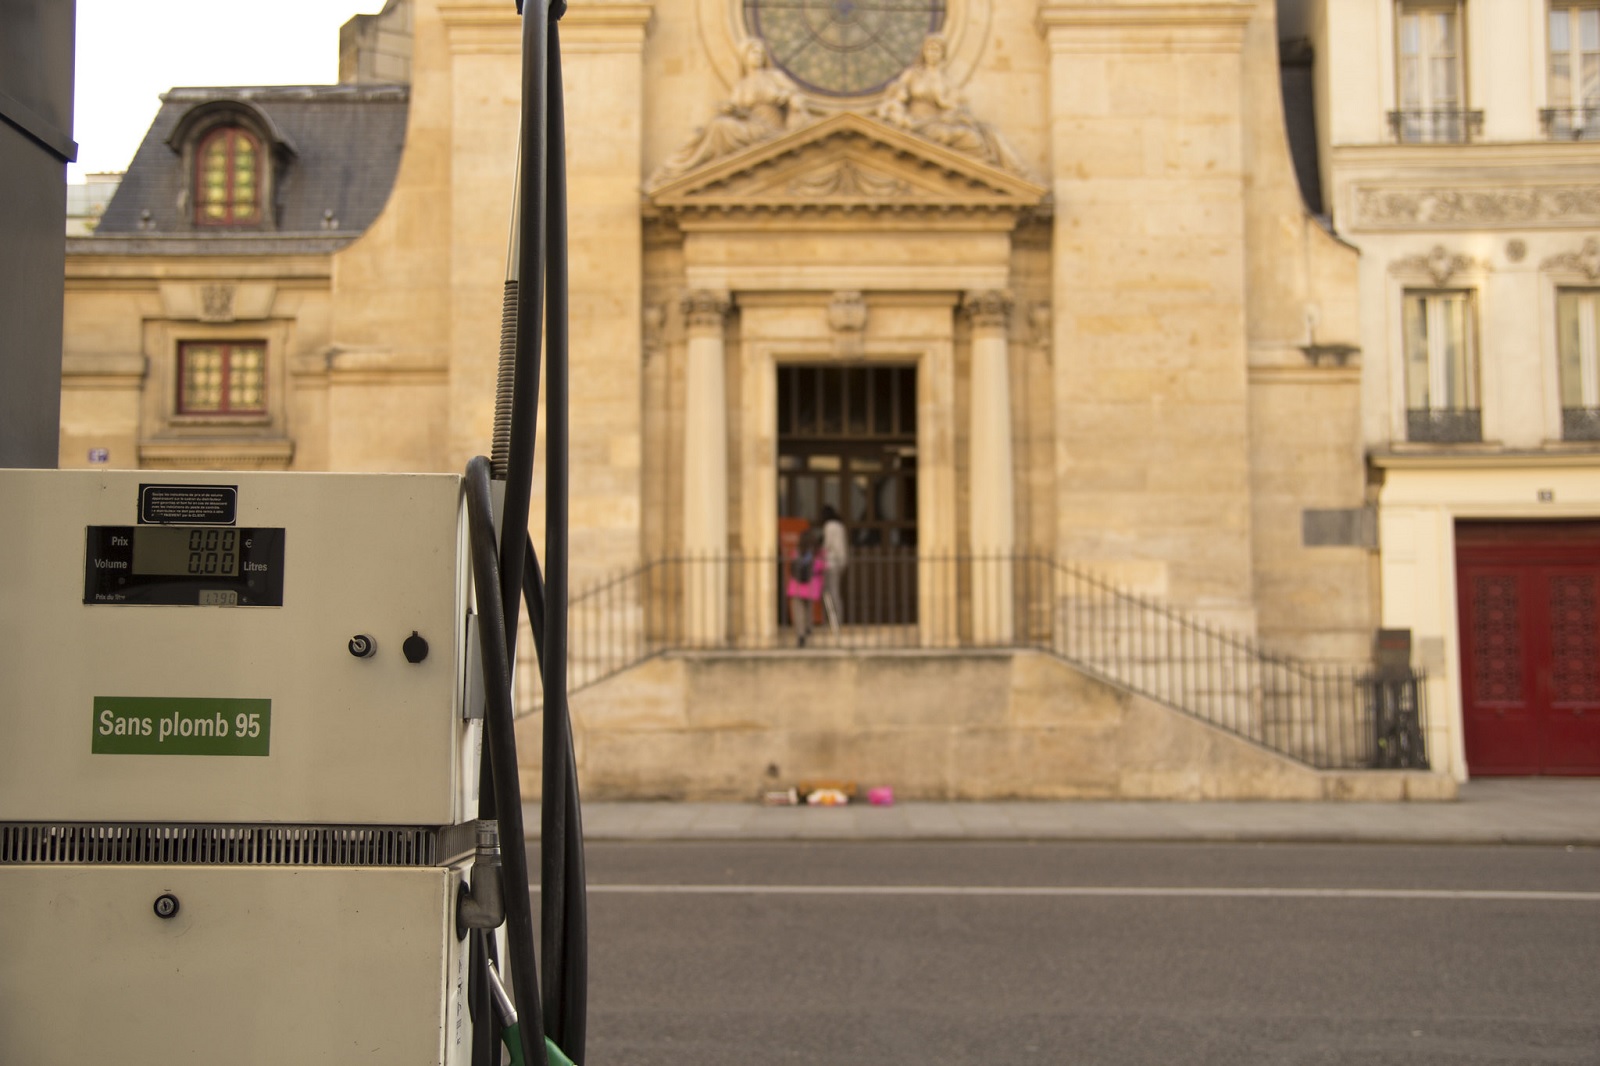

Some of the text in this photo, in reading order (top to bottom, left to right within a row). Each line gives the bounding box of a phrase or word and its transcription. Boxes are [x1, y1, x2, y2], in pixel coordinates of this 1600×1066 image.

[111, 536, 128, 546] Prix
[189, 530, 235, 552] 0,00
[95, 559, 127, 568] Volume
[188, 552, 268, 574] 0,00 Litres
[99, 710, 260, 742] Sans plomb 95
